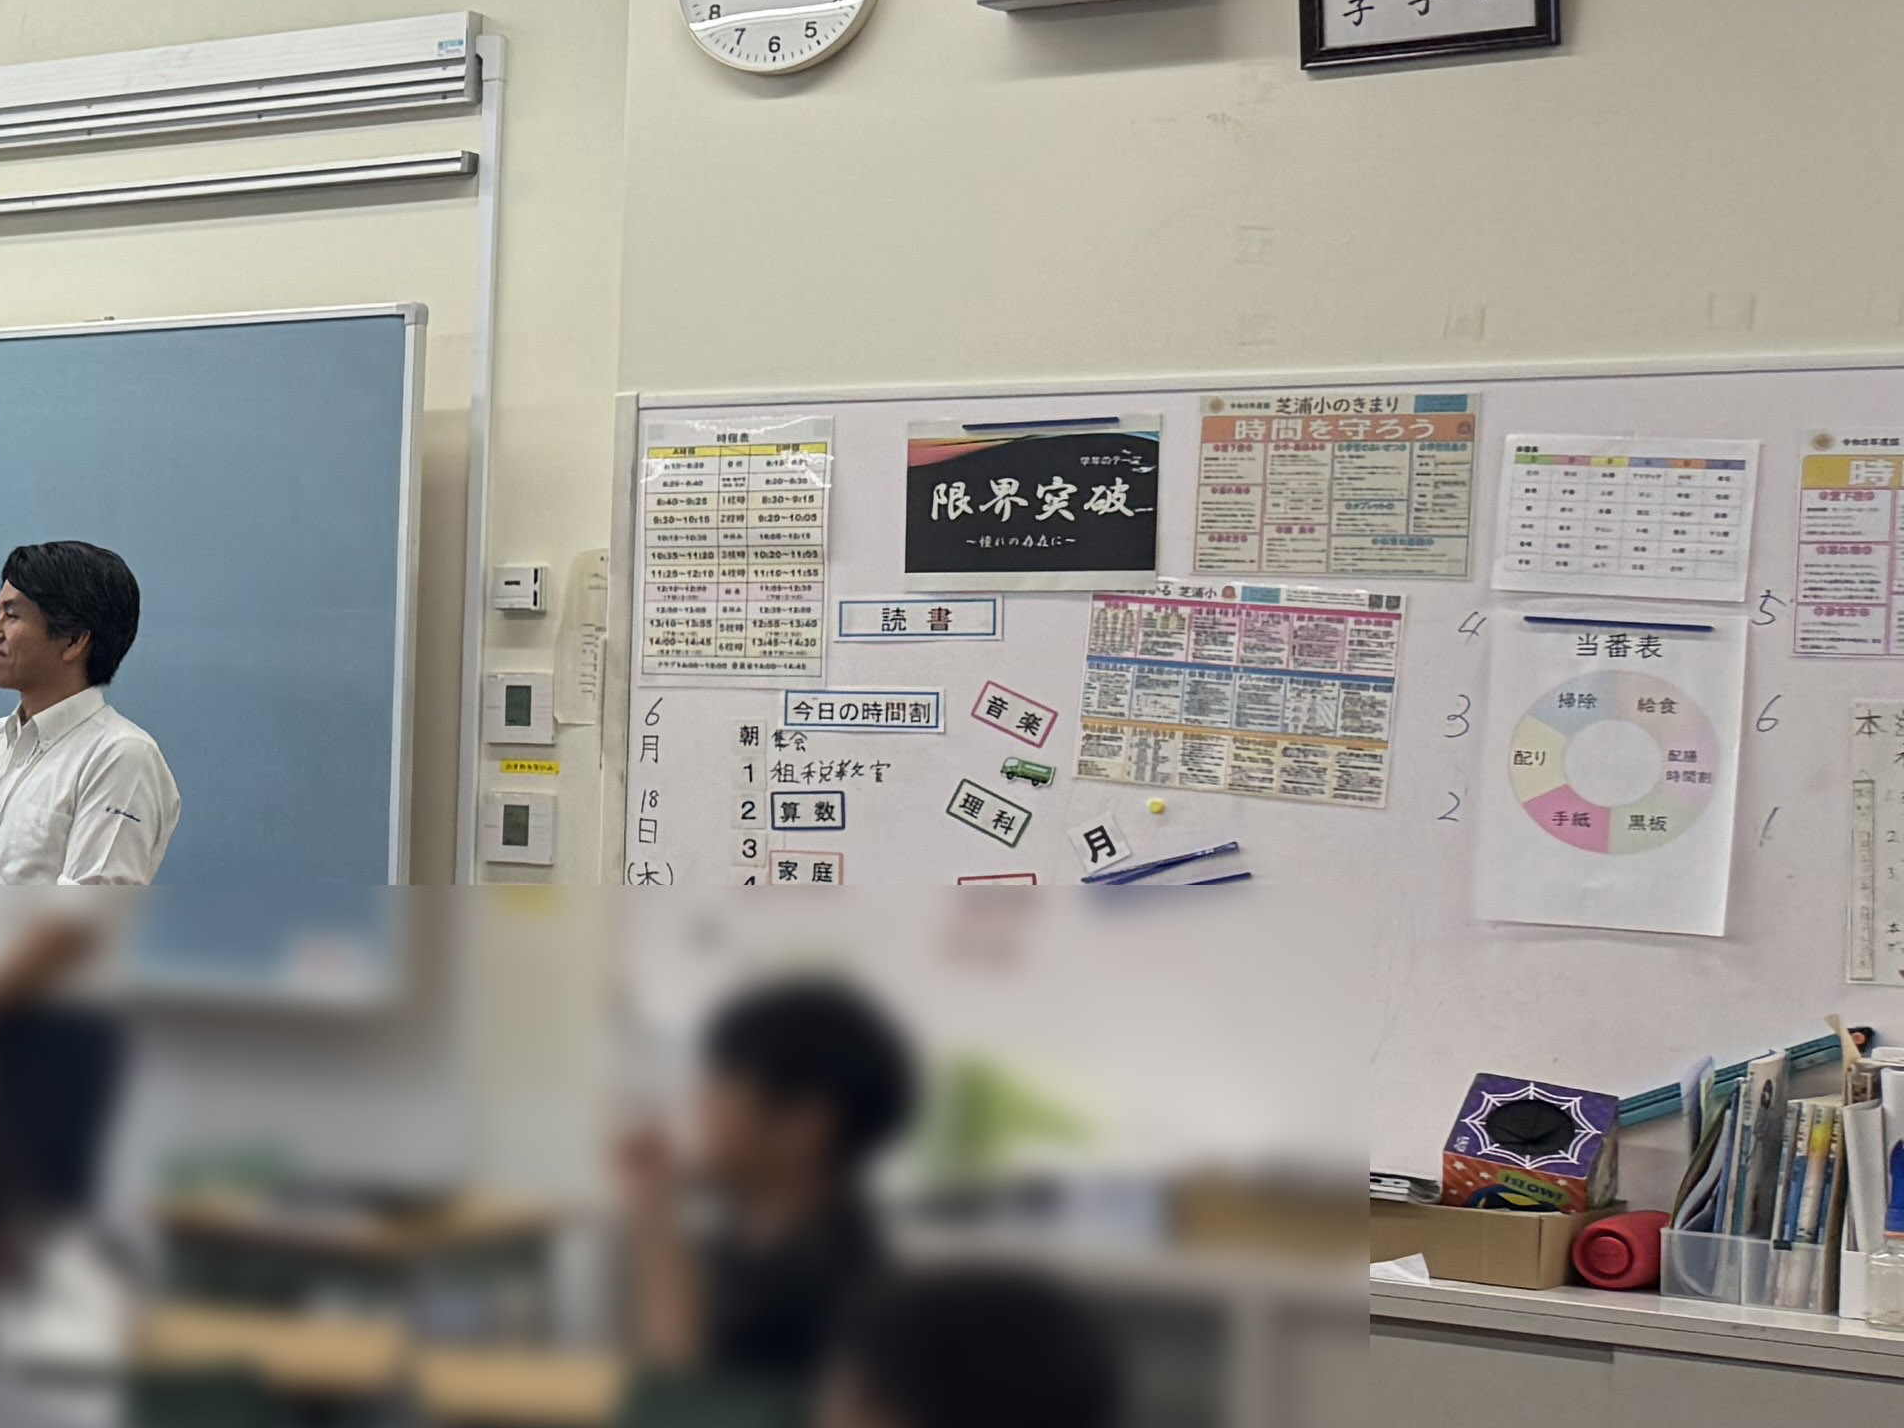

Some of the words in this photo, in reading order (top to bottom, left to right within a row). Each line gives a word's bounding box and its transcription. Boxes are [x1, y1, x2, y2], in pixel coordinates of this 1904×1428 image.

[709, 4, 721, 20] 8
[734, 28, 746, 45] 7
[805, 21, 817, 38] 5
[768, 36, 781, 53] 6
[1276, 397, 1398, 415] 芝浦小のきまり
[1235, 419, 1435, 440] 時間を守ろう
[931, 476, 1135, 522] 限界突破
[881, 606, 952, 632] 読書
[1751, 589, 1788, 626] 5
[1458, 611, 1487, 642] 4
[1576, 634, 1663, 659] 当番表
[792, 700, 931, 725] 今日の時間割
[1558, 692, 1598, 710] 掃除
[1637, 697, 1678, 714] 給食
[986, 695, 1042, 737] 音楽
[1444, 694, 1471, 738] 3
[1756, 694, 1782, 733] 6
[739, 725, 759, 747] 朝
[1513, 750, 1546, 766] 配り
[743, 763, 753, 783] 1
[741, 800, 757, 820] 2
[780, 801, 836, 823] 算数
[959, 792, 1016, 835] 理科
[1437, 792, 1461, 822] 2
[1552, 811, 1591, 829] 手紙
[1628, 814, 1668, 832] 黒板
[1083, 825, 1117, 864] 月
[742, 838, 757, 859] 3
[778, 860, 833, 883] 家庭
